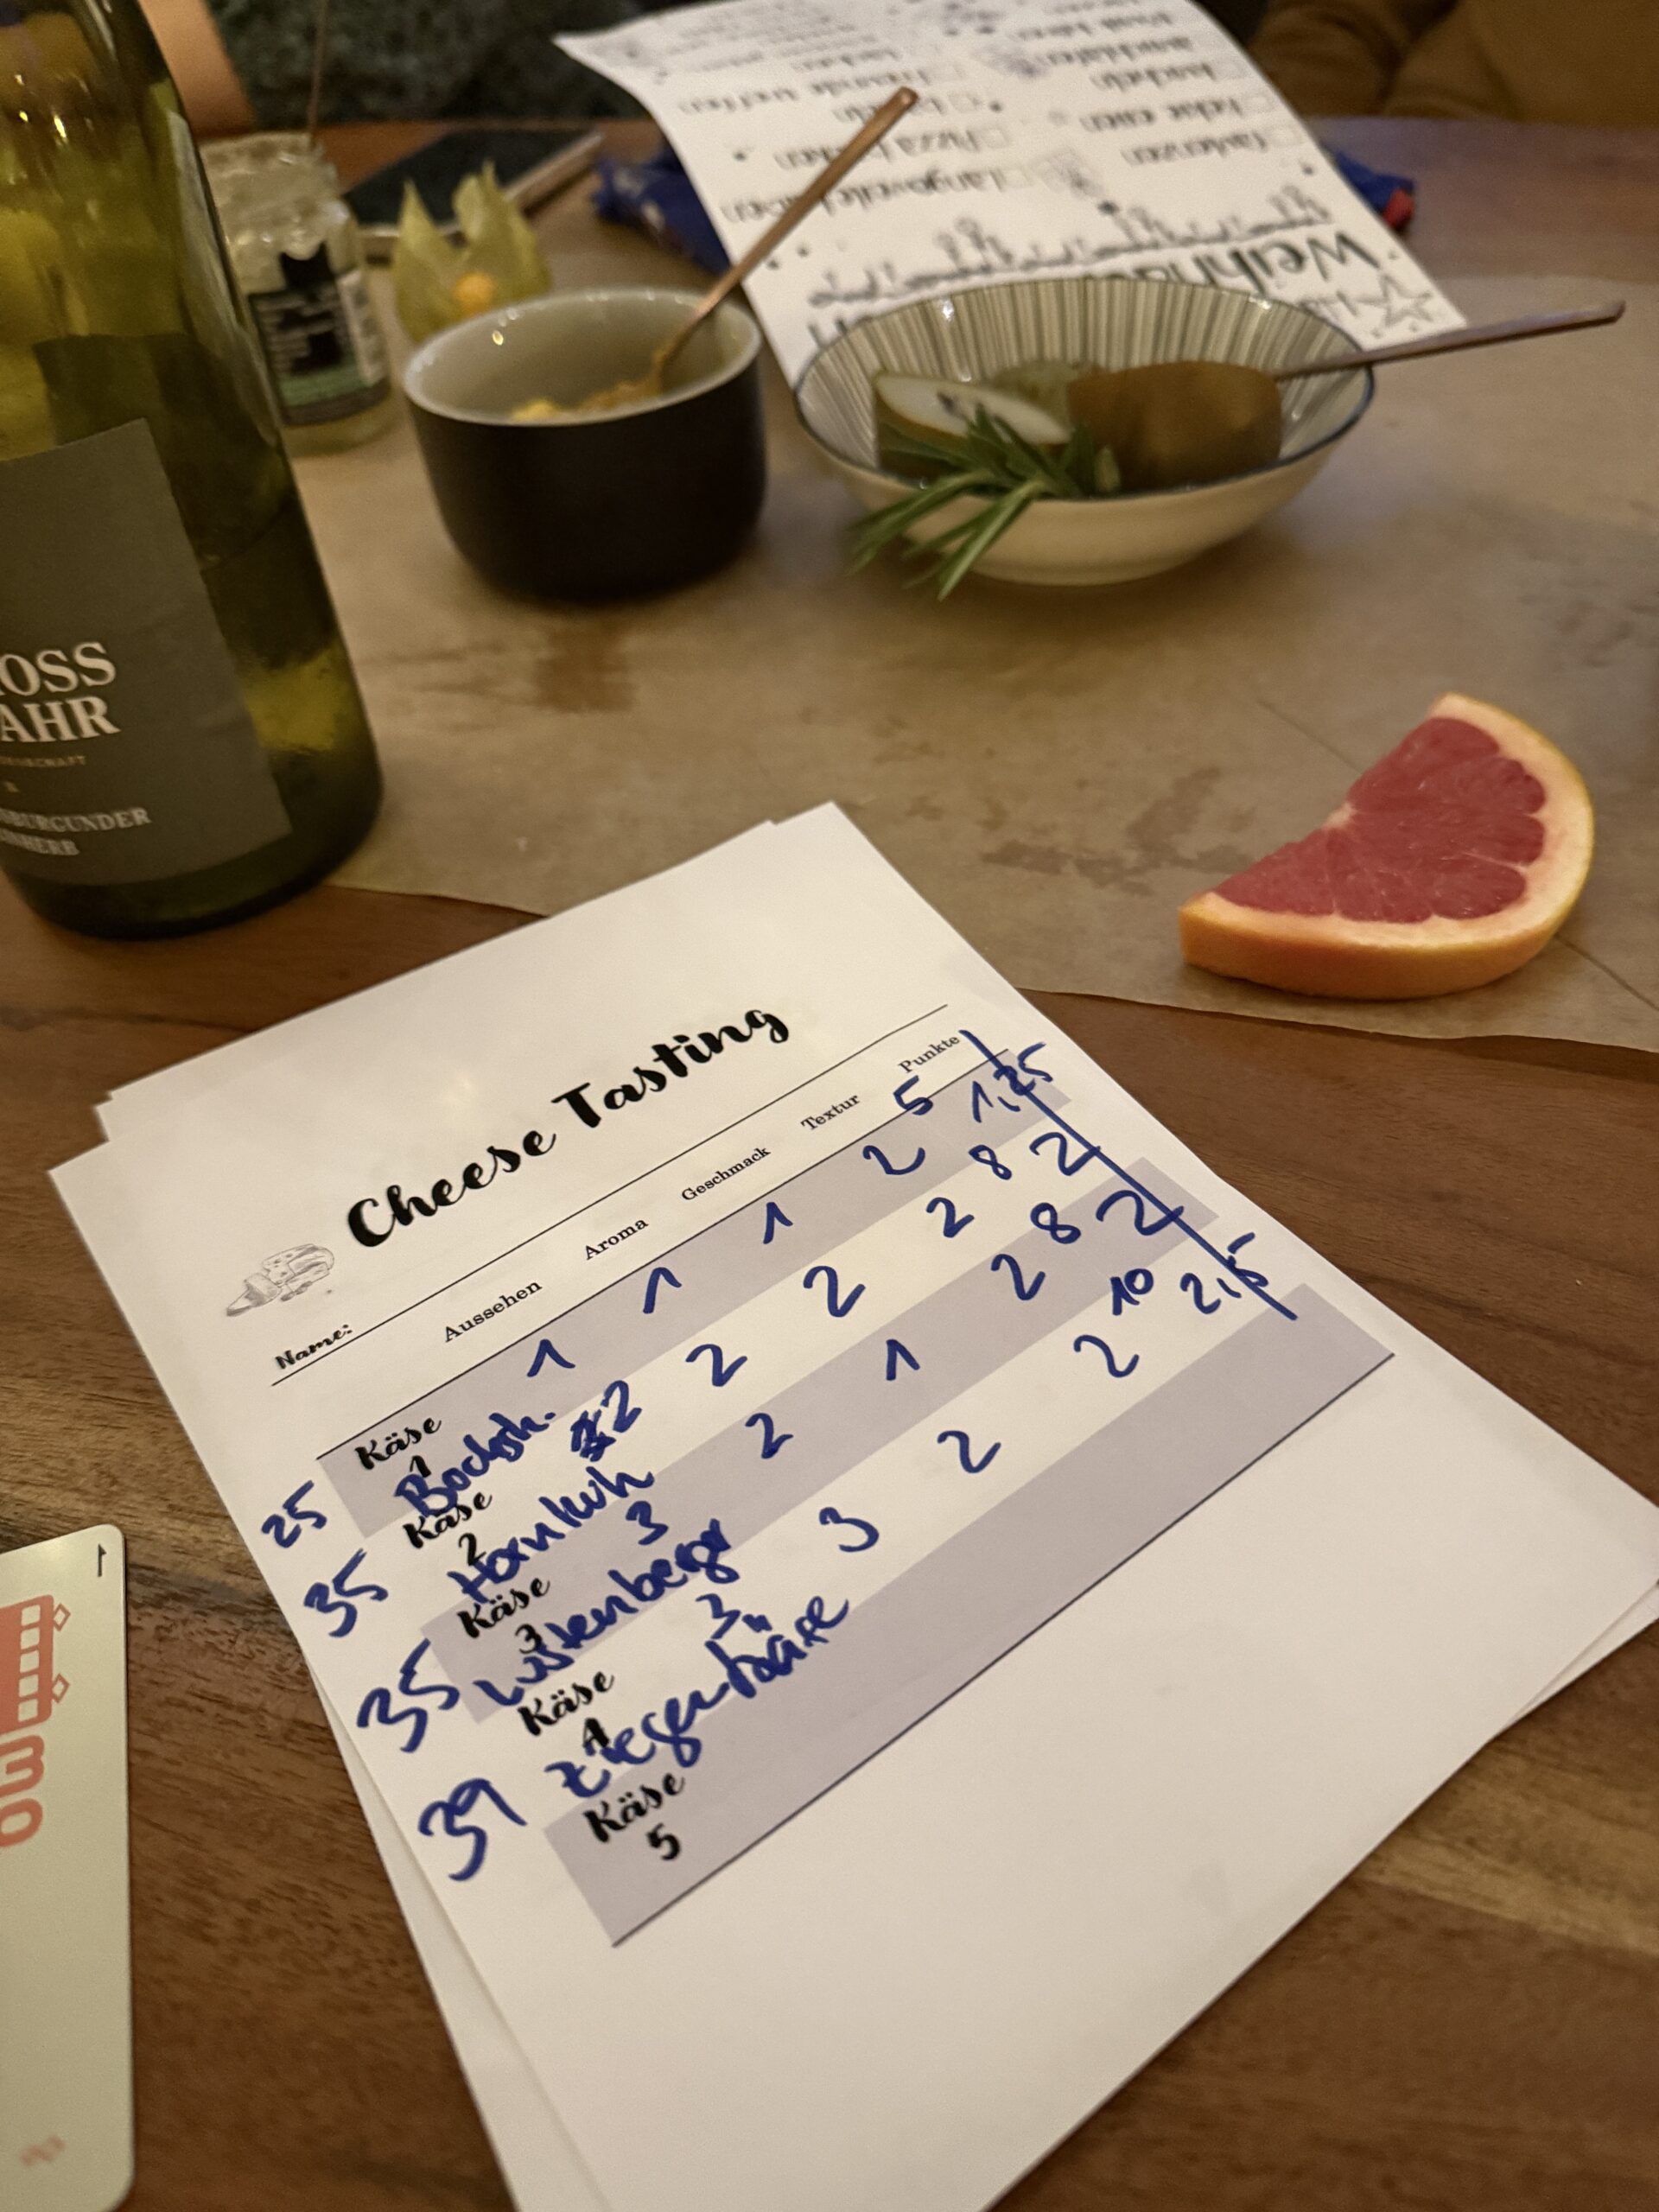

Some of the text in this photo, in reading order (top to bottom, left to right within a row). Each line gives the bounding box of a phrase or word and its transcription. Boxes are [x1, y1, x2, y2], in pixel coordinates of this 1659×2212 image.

[0, 641, 116, 696] OSS
[347, 1003, 790, 1248] Cheese Tasting
[893, 1076, 933, 1115] 5
[443, 1033, 961, 1343] Aussehen Aroma Geschmack Textur Punkte
[863, 1145, 925, 1175] 2
[685, 1344, 747, 1387] 2
[803, 1266, 865, 1318] 2
[926, 1197, 975, 1238] 2
[969, 1144, 1013, 1180] 8
[1029, 1131, 1102, 1177] 2
[274, 1324, 354, 1370] Name:
[626, 1500, 669, 1546] 3
[745, 1412, 794, 1459] 2
[990, 1254, 1046, 1301] 2
[1030, 1202, 1082, 1244] 8
[1096, 1189, 1185, 1236] 2
[354, 1417, 442, 1470] Käse
[695, 1592, 741, 1640] 3
[818, 1507, 880, 1553] 3
[937, 1430, 1001, 1473] 2
[1073, 1334, 1140, 1378] 2
[1109, 1268, 1154, 1317] 10
[261, 1479, 328, 1548] 25
[458, 1532, 487, 1567] 2
[303, 1548, 389, 1637] 35
[457, 1578, 550, 1638] Käse
[515, 1623, 543, 1655] 3
[356, 1637, 461, 1754] 35
[518, 1670, 614, 1737] Käse
[417, 1777, 528, 1882] 39
[583, 1771, 685, 1843] Käse
[645, 1822, 682, 1861] 5
